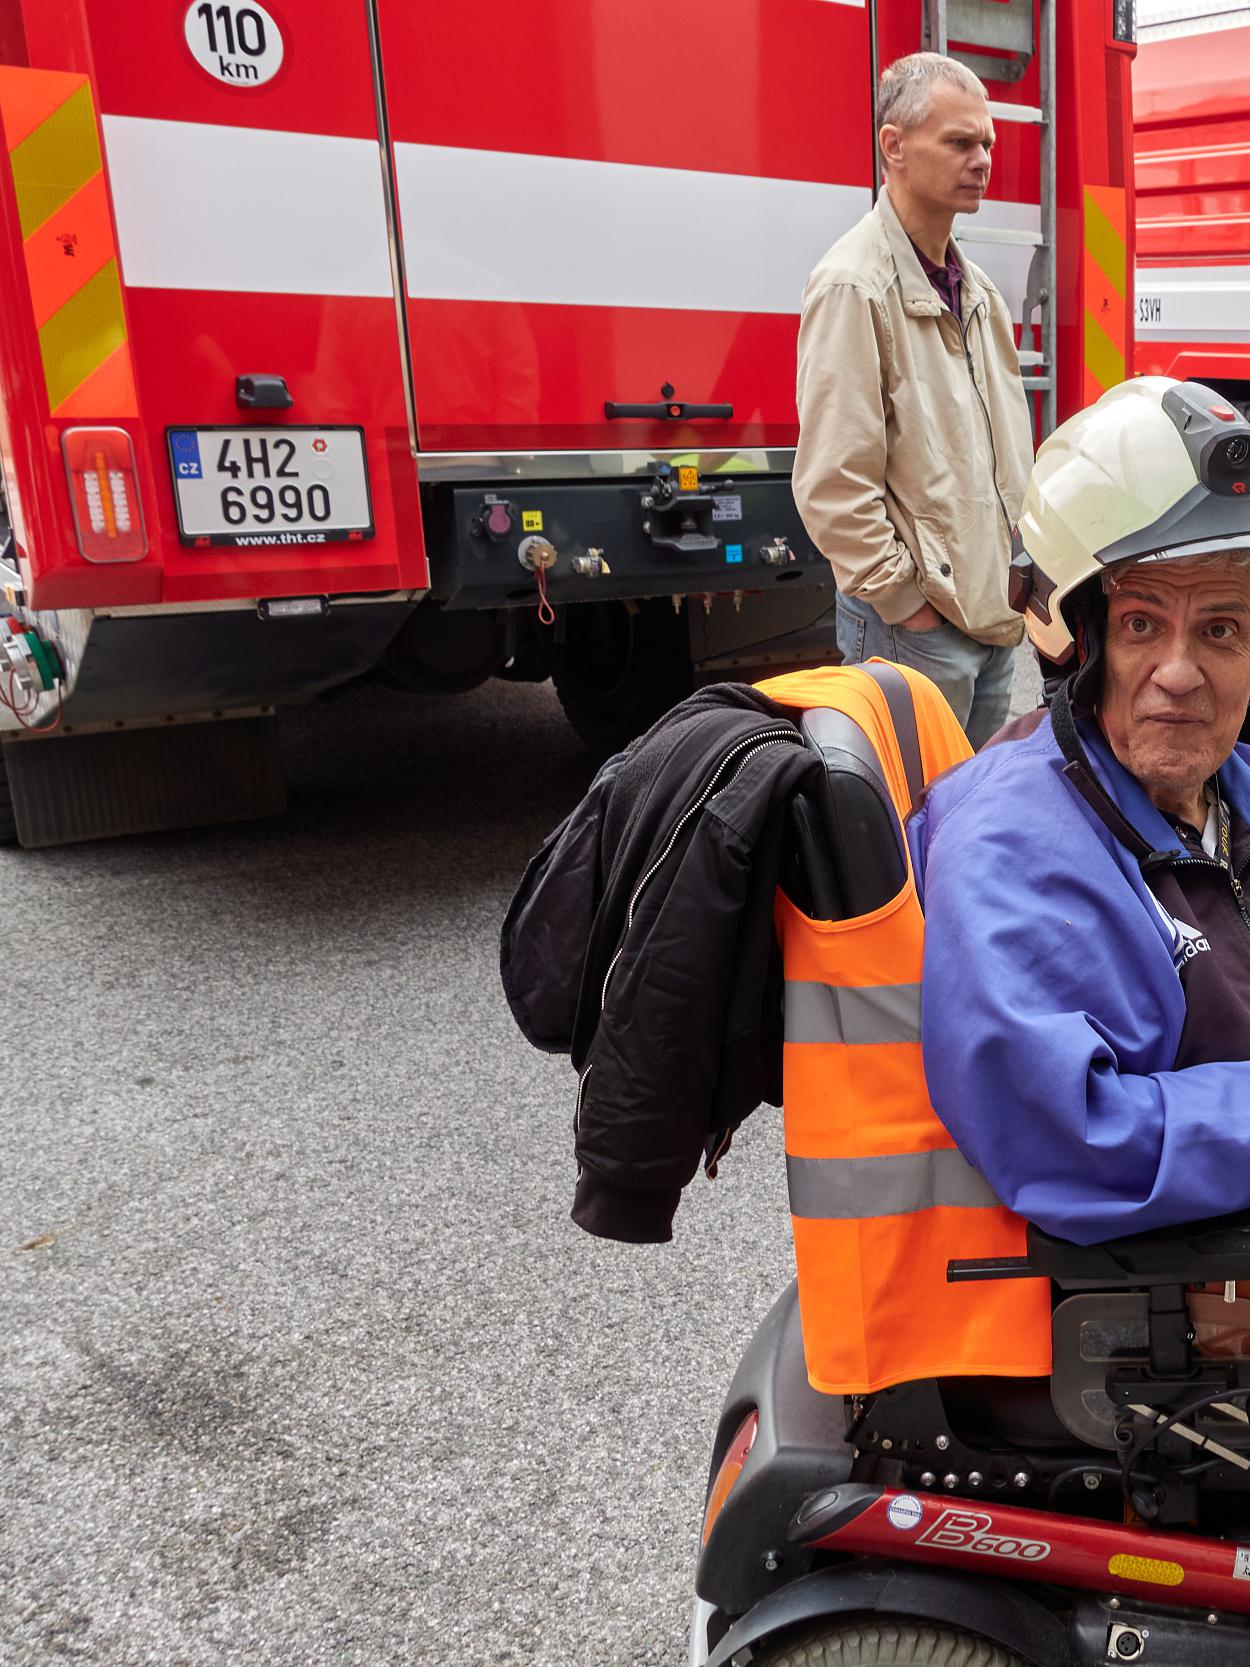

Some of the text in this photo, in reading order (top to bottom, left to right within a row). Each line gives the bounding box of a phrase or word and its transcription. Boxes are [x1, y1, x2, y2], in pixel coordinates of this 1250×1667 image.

[197, 3, 266, 57] 110
[218, 55, 258, 80] km
[1140, 298, 1161, 322] S3VH
[178, 462, 199, 475] CZ
[217, 438, 299, 479] 4H2
[220, 483, 331, 525] 6990
[235, 533, 326, 547] www.tht.cz
[915, 1508, 1051, 1562] B600
